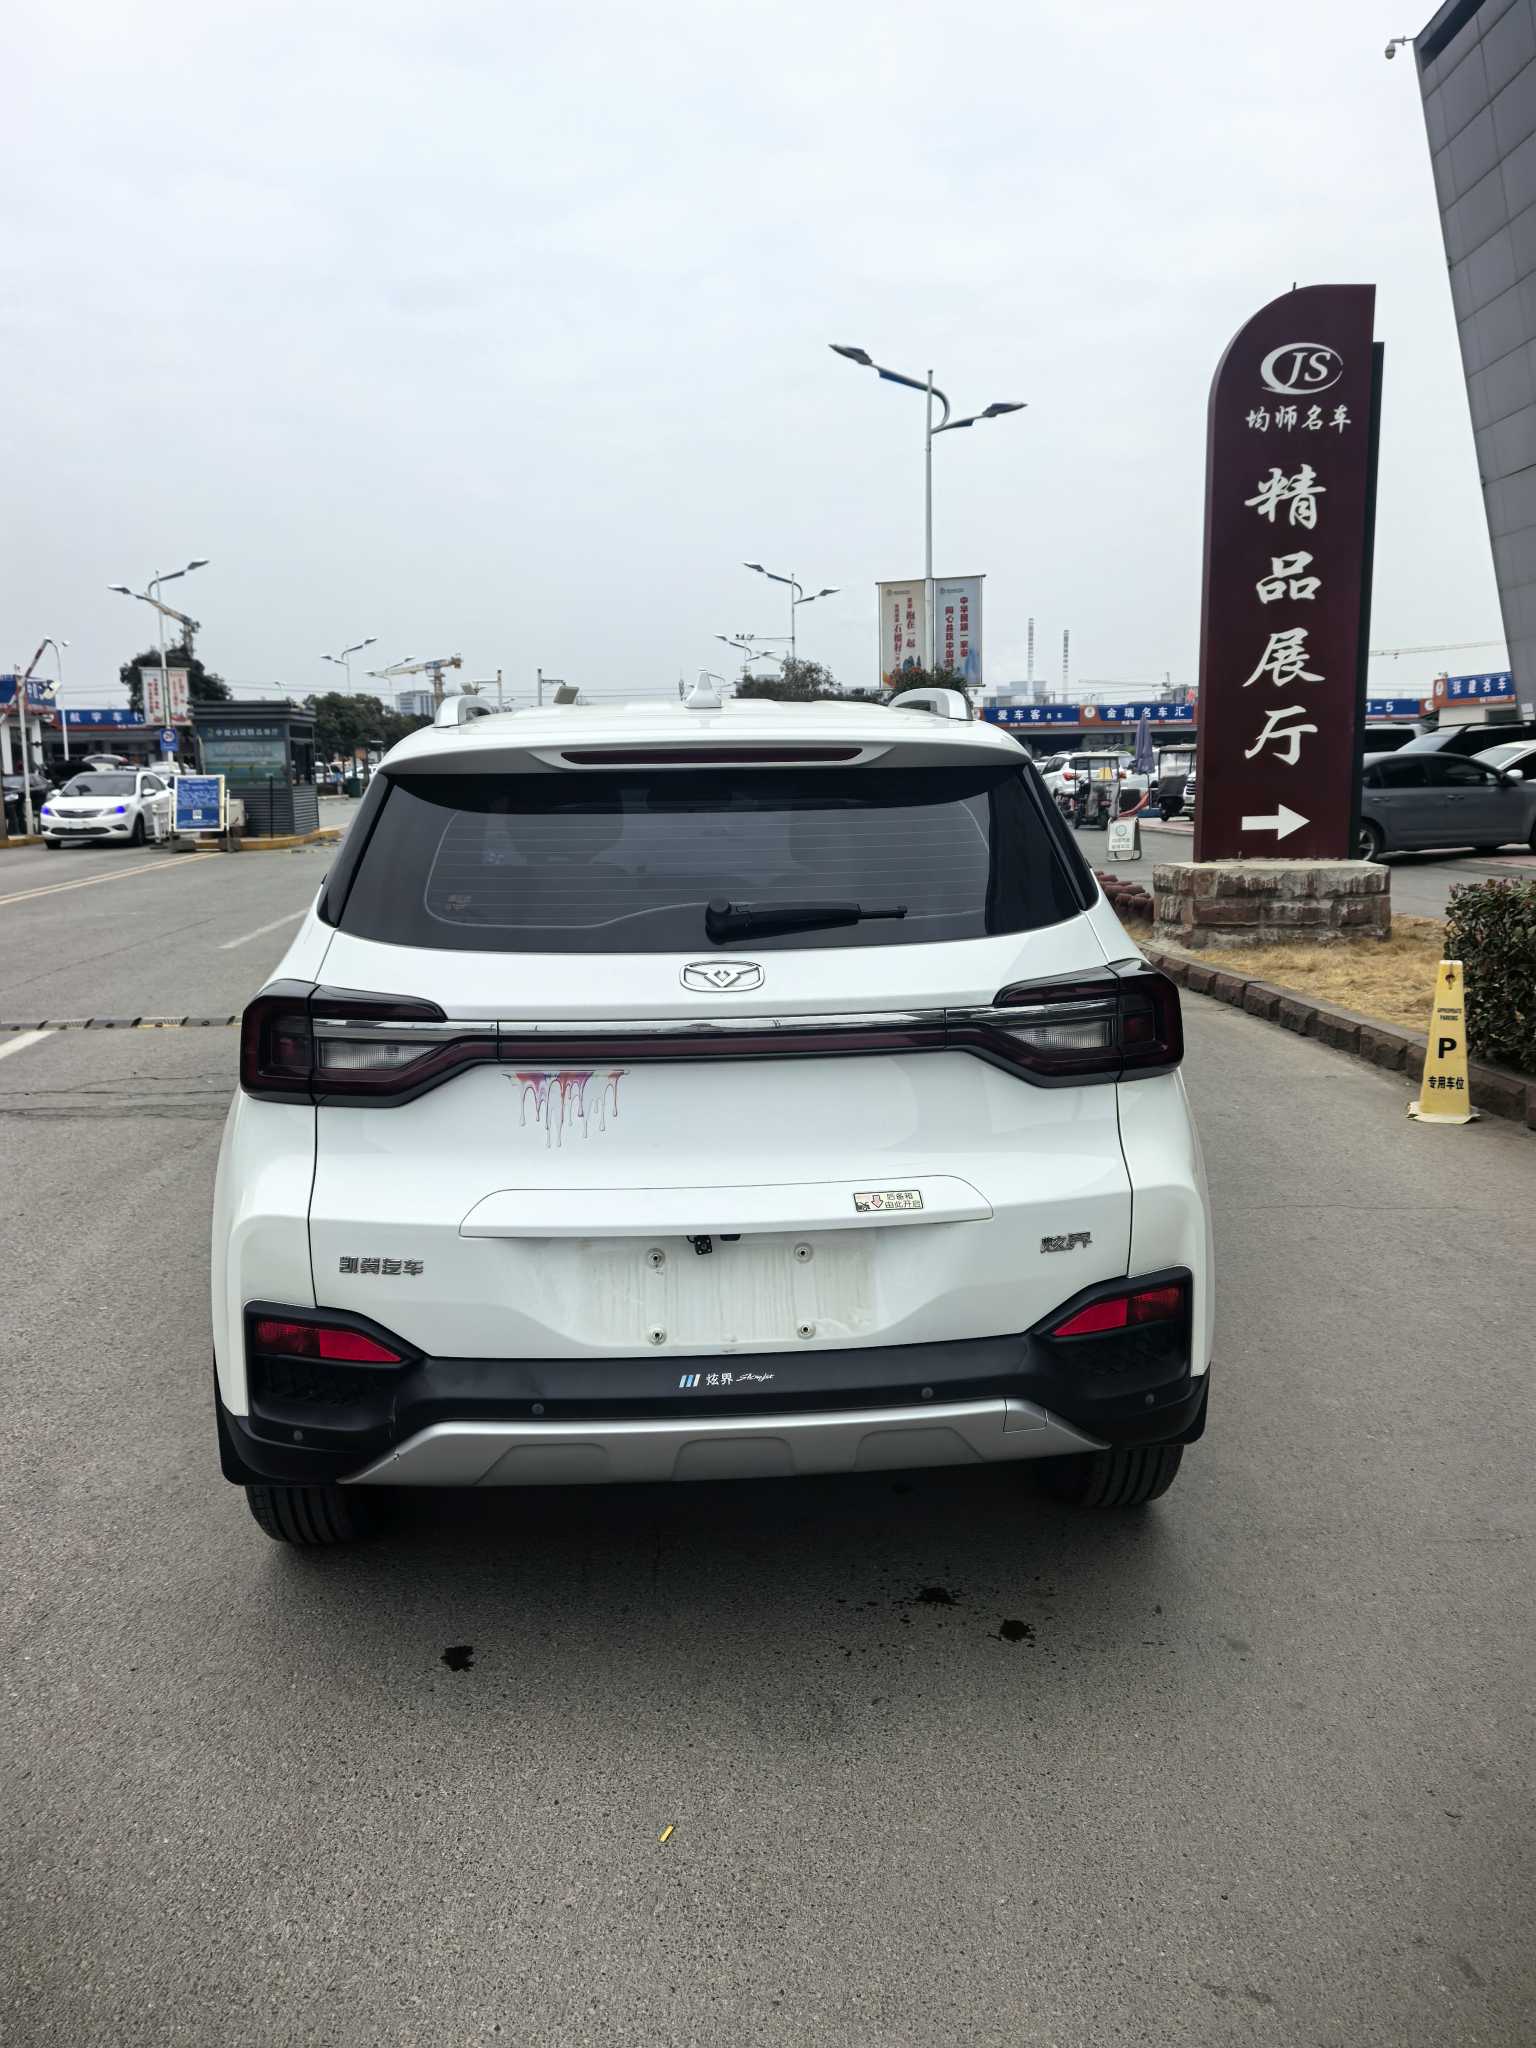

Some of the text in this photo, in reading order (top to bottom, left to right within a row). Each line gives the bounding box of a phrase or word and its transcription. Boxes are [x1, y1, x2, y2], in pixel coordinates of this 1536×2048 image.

[1245, 404, 1352, 434] 均师名车
[1243, 463, 1328, 766] 精品展厅
[1438, 1037, 1457, 1059] P
[1428, 1076, 1465, 1090] 专用车位
[339, 1256, 424, 1276] 凯翼汽车
[706, 1372, 734, 1386] 炫界
